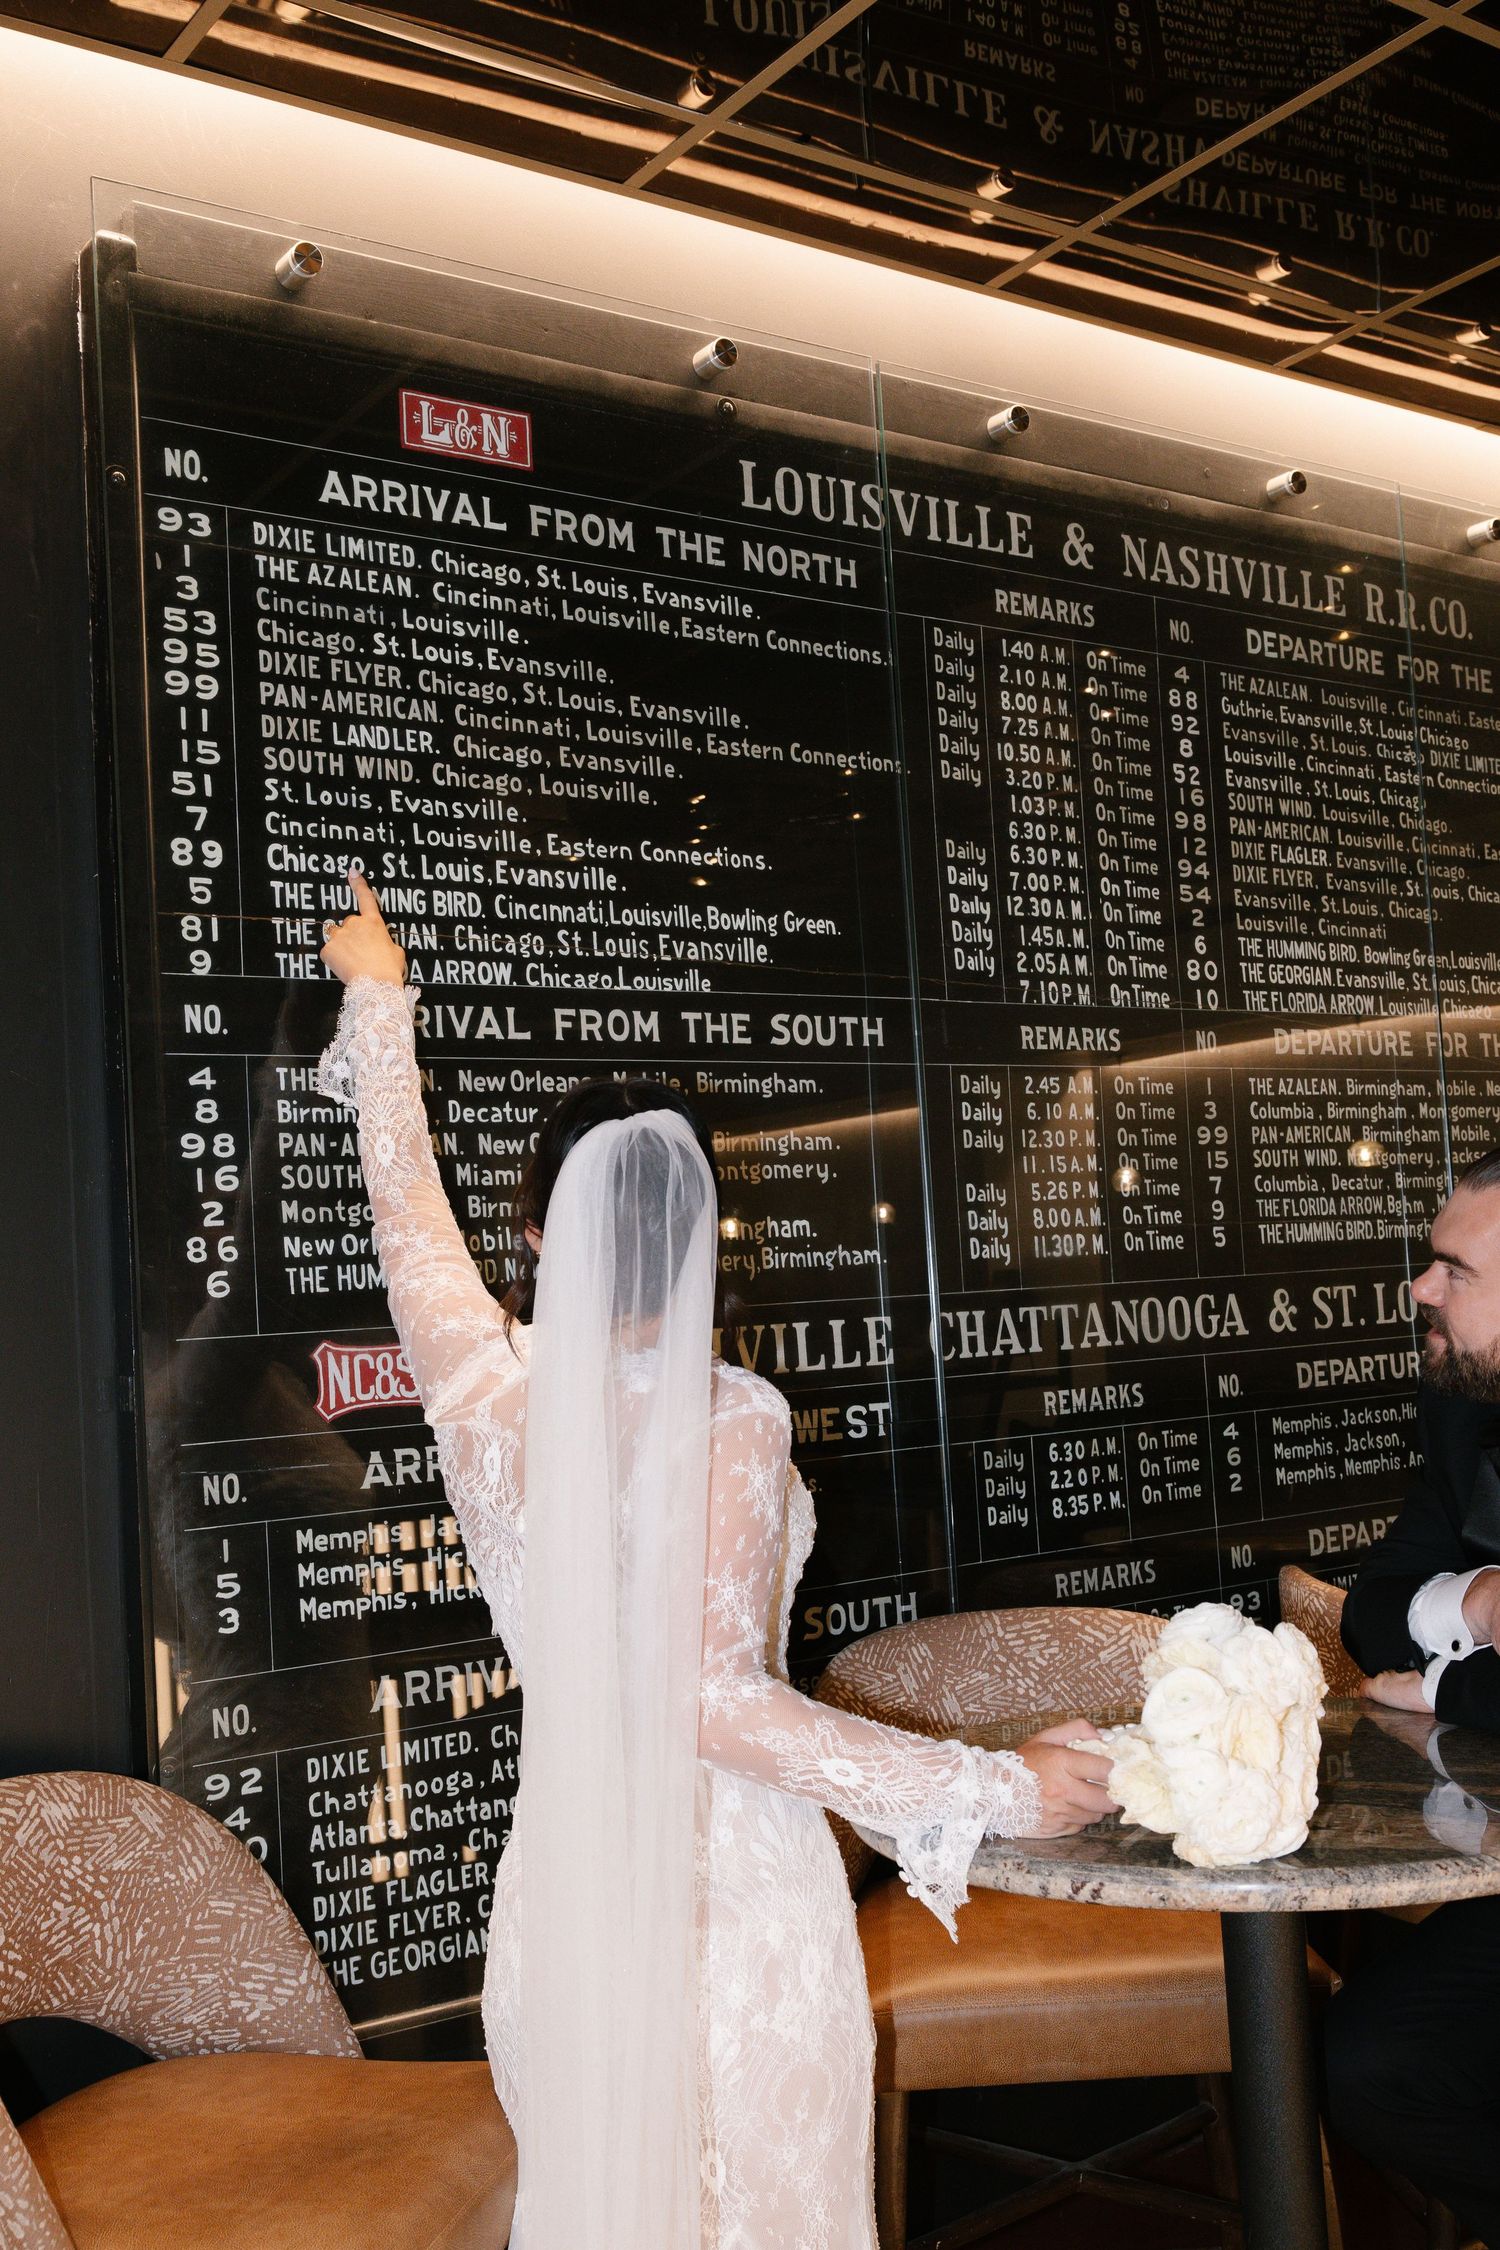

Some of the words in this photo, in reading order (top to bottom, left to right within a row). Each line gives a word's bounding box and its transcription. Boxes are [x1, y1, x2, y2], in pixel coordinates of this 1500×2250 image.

[418, 399, 510, 459] L&N
[163, 446, 208, 483] NO.
[156, 505, 212, 538] 93
[317, 469, 507, 532] ARRIVAL
[528, 503, 636, 553] FROM
[654, 525, 726, 567] THE
[741, 539, 858, 589] NORTH
[738, 458, 1033, 559] LOUISVILLE
[1061, 521, 1094, 570] &
[1120, 532, 1346, 617] NASHVILLE
[252, 520, 316, 554] DIXIE
[324, 531, 422, 569] LIMITED.
[535, 563, 566, 590] St.
[641, 581, 760, 620] Evansville.
[175, 574, 199, 601] 3
[253, 553, 300, 583] THE
[306, 561, 420, 599] AZALEAN.
[680, 615, 759, 648] Eastern
[162, 605, 217, 636] 53
[994, 587, 1095, 628] REMARKS
[371, 631, 406, 659] St.
[932, 625, 974, 657] Daily
[1168, 618, 1194, 644] NO.
[162, 637, 220, 669] 95
[1001, 637, 1034, 661] 1.40
[1085, 649, 1107, 672] On
[1109, 653, 1146, 677] Time
[1245, 627, 1385, 676] DEPARTURE
[1396, 653, 1439, 684] FOR
[1450, 663, 1493, 694] THE
[163, 669, 219, 701] 99
[257, 648, 321, 679] DIXIE
[329, 657, 411, 690] FLYER.
[521, 680, 553, 706] St.
[629, 694, 749, 730] Evansville.
[1173, 665, 1190, 684] 4
[1219, 670, 1246, 692] THE
[260, 713, 322, 743] DIXIE
[558, 745, 683, 779] Evansville.
[705, 731, 783, 761] Eastern
[939, 758, 982, 788] Daily
[1004, 766, 1043, 790] 3.20
[1092, 775, 1114, 797] On
[1116, 779, 1153, 802] Time
[1179, 786, 1205, 807] 16
[185, 804, 208, 832] 7
[169, 836, 223, 869] 89
[188, 875, 212, 905] 5
[188, 948, 213, 976] 9
[1236, 935, 1264, 958] THE
[1265, 937, 1327, 962] HUMMING
[183, 1003, 228, 1035] NO.
[552, 1007, 661, 1043] FROM
[680, 1010, 752, 1045] THE
[769, 1012, 884, 1047] SOUTH
[1019, 1024, 1121, 1052] REMARKS
[1272, 1027, 1413, 1057] DEPARTURE
[187, 1065, 217, 1090] 4
[457, 1068, 506, 1093] New
[695, 1070, 824, 1098] Birmingham.
[959, 1073, 1001, 1100] Daily
[1023, 1074, 1060, 1095] 2.45
[1113, 1074, 1134, 1095] On
[1137, 1075, 1174, 1095] Time
[194, 1098, 219, 1124] 8
[179, 1132, 235, 1159] 98
[1252, 1148, 1299, 1168] SOUTH
[966, 1208, 1009, 1239] Daily
[1032, 1206, 1071, 1229] 8.00
[1121, 1204, 1143, 1225] On
[1141, 1203, 1183, 1225] Time
[1210, 1198, 1225, 1221] 9
[185, 1234, 239, 1263] 86
[927, 1290, 1249, 1363] CHATTANOOGA
[1268, 1287, 1298, 1333] &
[1311, 1284, 1366, 1329] ST.
[1295, 1349, 1427, 1389] DEPARTUR
[1042, 1381, 1144, 1417] REMARKS
[1217, 1372, 1244, 1398] NO.
[1136, 1430, 1158, 1451] On
[1160, 1428, 1198, 1448] Time
[1221, 1421, 1239, 1440] 4
[982, 1447, 1024, 1472] Daily
[1047, 1439, 1085, 1463] 6.30
[202, 1471, 247, 1506] NO.
[1230, 1543, 1256, 1569] NO.
[214, 1571, 241, 1600] 5
[1054, 1558, 1156, 1599] REMARKS
[217, 1606, 240, 1634] 3
[803, 1590, 918, 1640] SOUTH
[211, 1702, 257, 1739] NO.
[306, 1747, 370, 1783] DIXIE
[203, 1766, 263, 1802] 92
[312, 1884, 376, 1922] DIXIE
[313, 1917, 378, 1959] DIXIE
